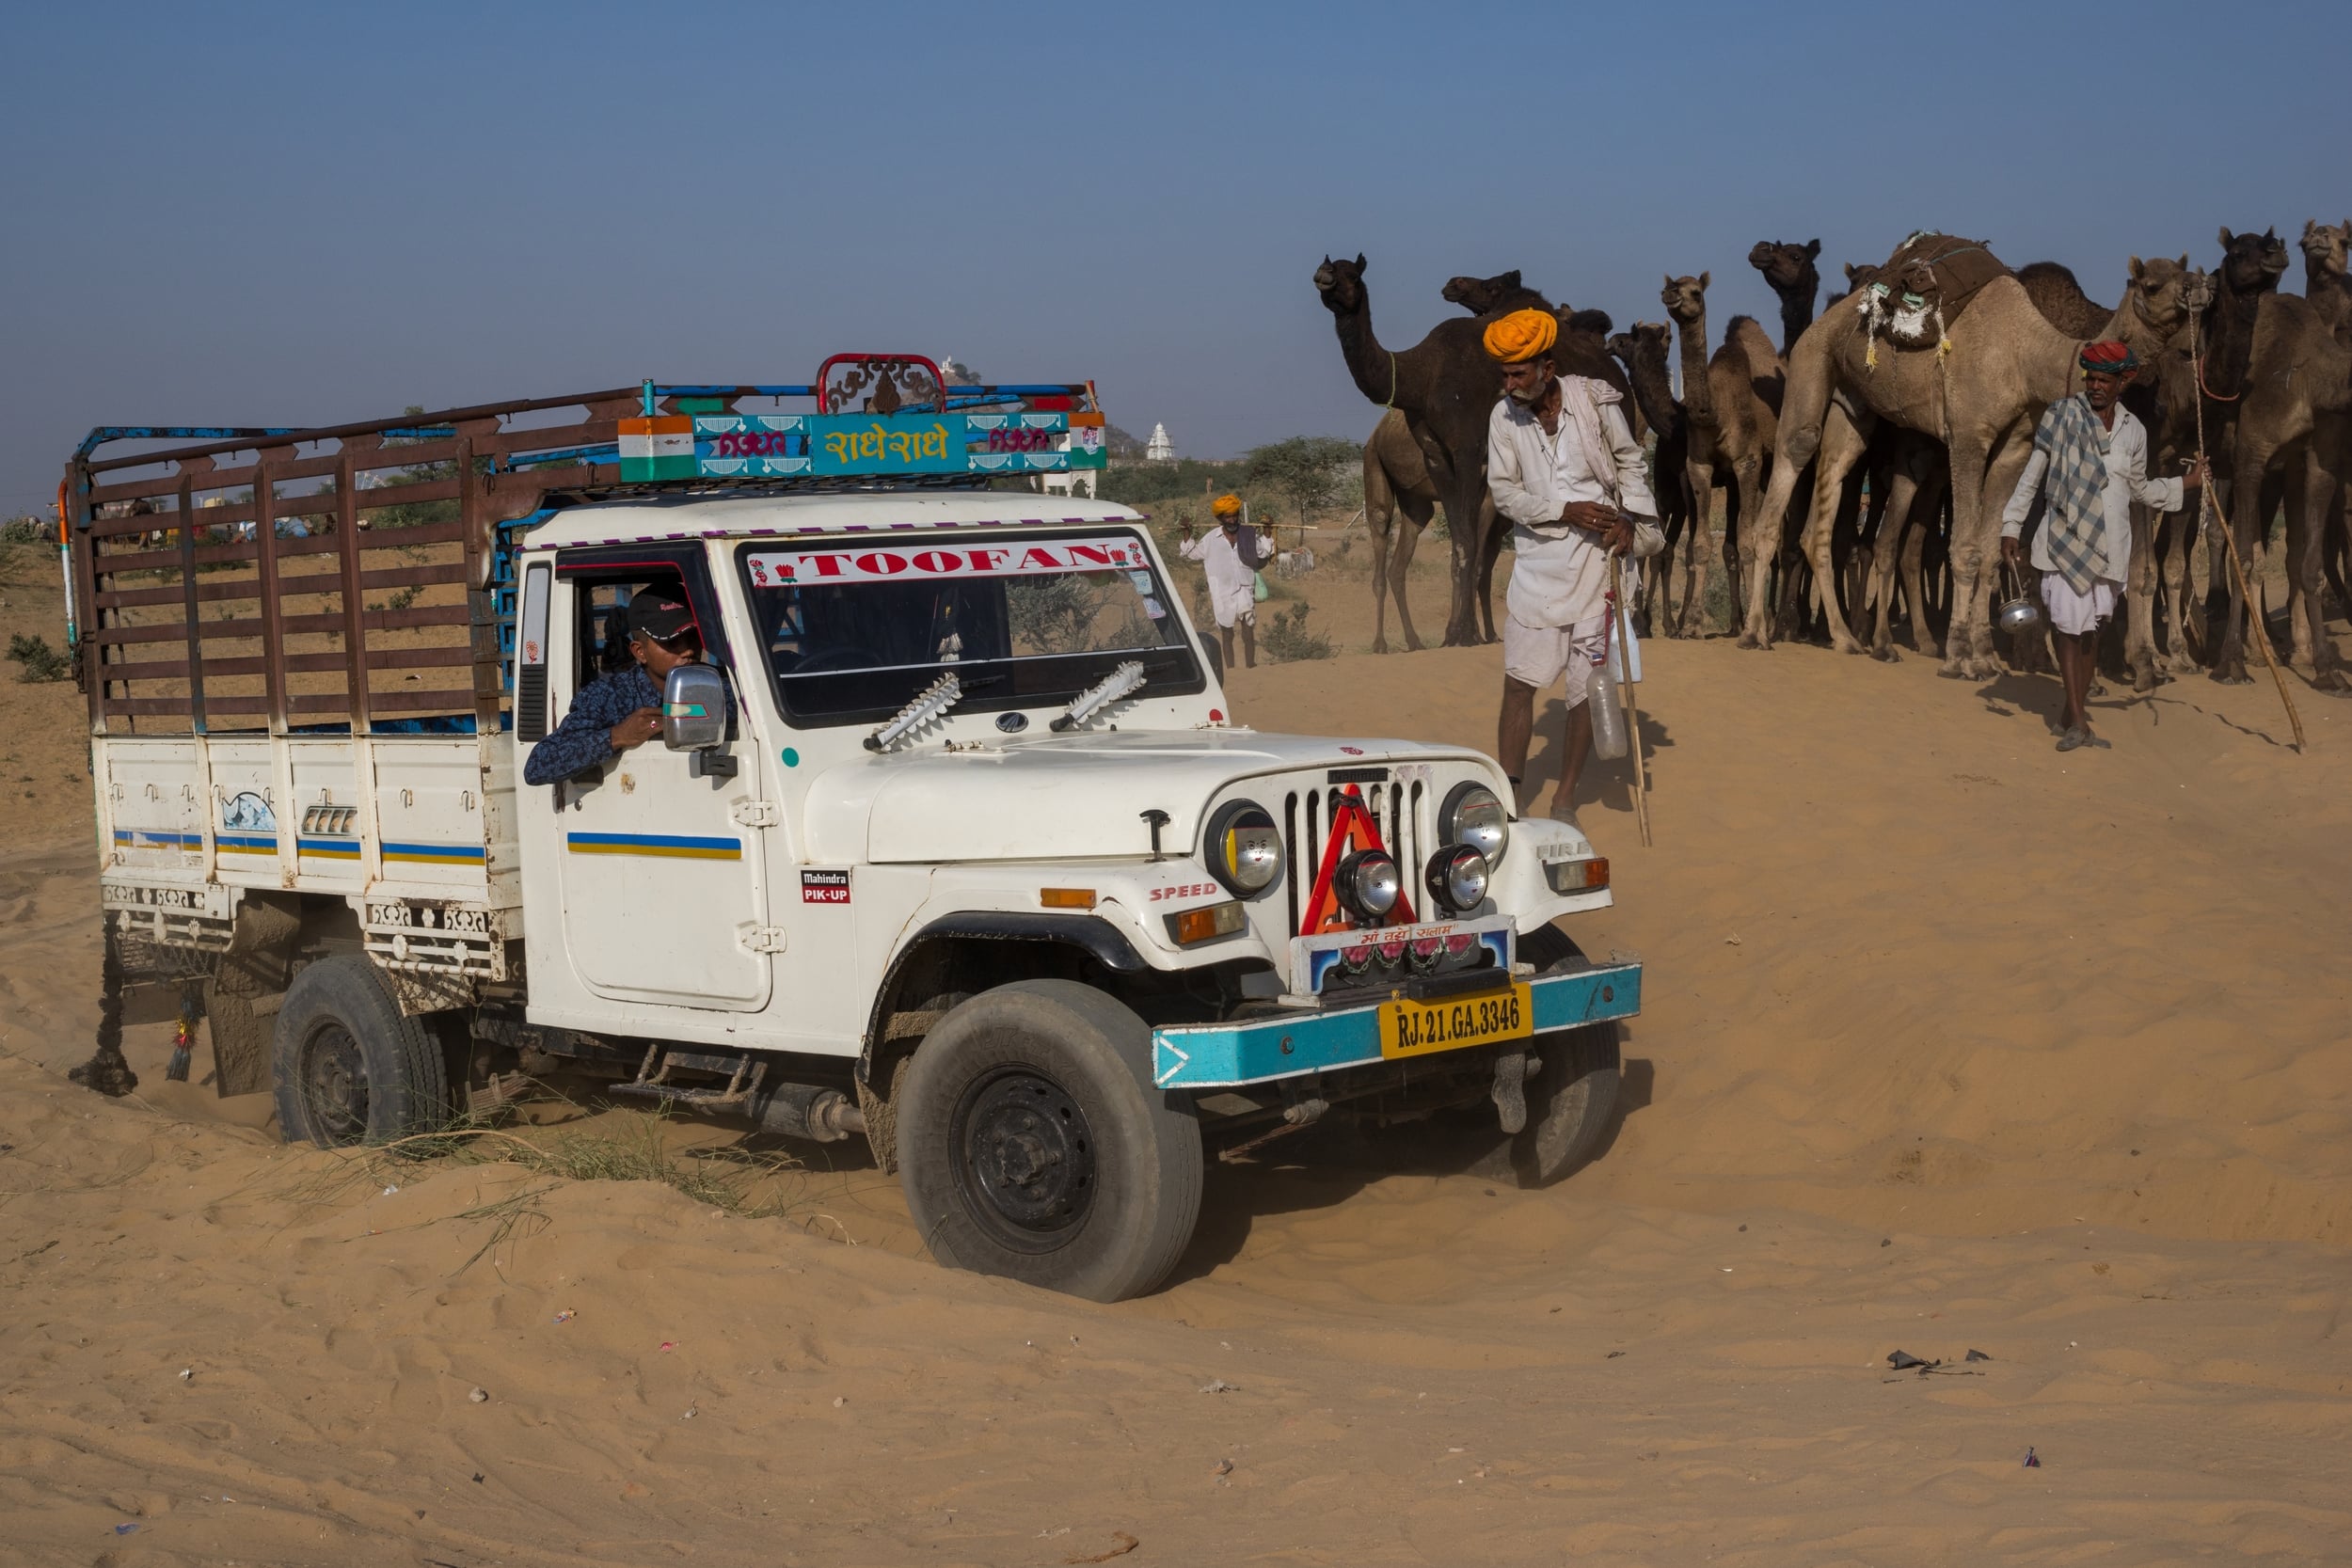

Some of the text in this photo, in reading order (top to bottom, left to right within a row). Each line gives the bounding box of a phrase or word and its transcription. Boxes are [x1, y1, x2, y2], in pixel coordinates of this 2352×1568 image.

[798, 544, 1110, 578] TOOFAN
[1535, 841, 1590, 859] FIRE
[803, 873, 847, 884] Mahindra
[804, 889, 848, 900] PIK-UP
[1149, 882, 1217, 902] SPEED
[1397, 997, 1520, 1049] RJ.21.GA.3346
